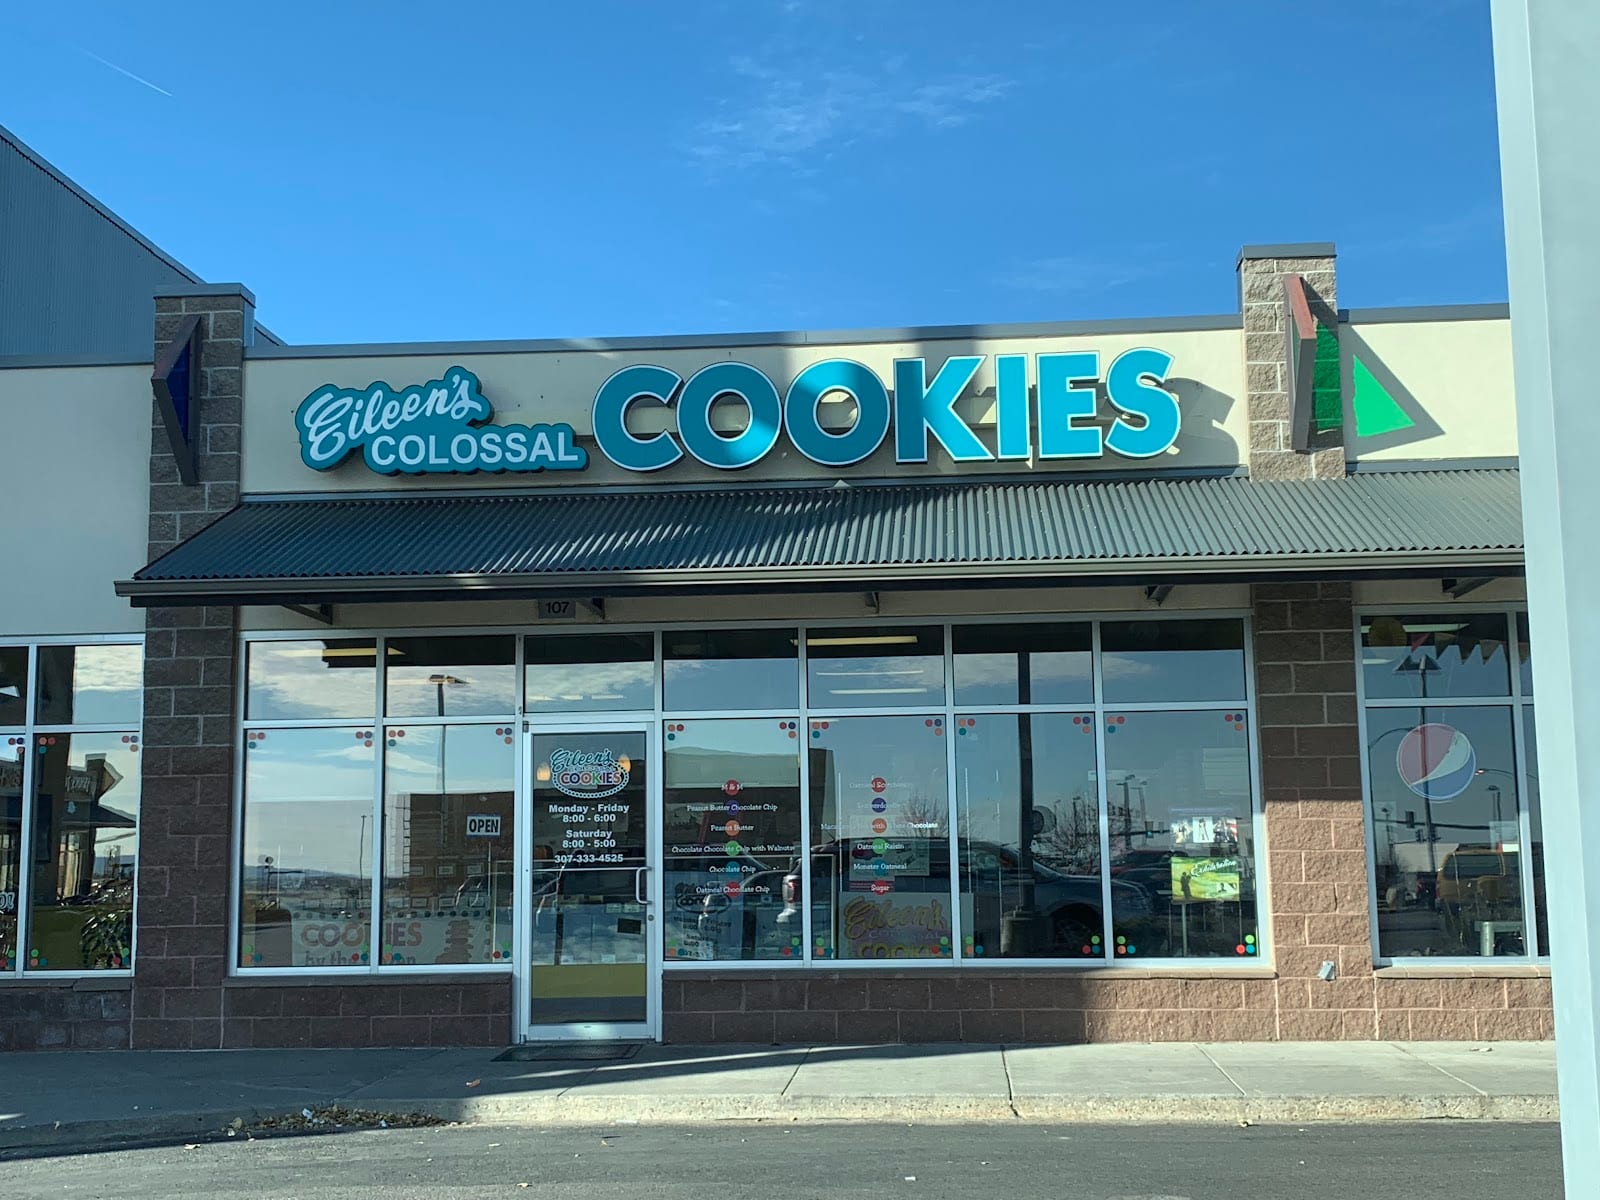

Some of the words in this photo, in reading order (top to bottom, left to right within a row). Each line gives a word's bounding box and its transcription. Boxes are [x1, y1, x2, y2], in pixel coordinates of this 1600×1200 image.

[592, 346, 1182, 472] COOKIES
[303, 373, 483, 461] Eileen's
[371, 430, 579, 466] COLOSSAL
[545, 600, 570, 614] 107
[551, 749, 614, 773] Eileen's
[560, 772, 622, 785] COOKIES
[549, 804, 588, 814] Monday
[598, 804, 629, 813] Friday
[687, 804, 708, 812] Peanut
[731, 803, 762, 811] Chocolate
[763, 803, 778, 811] Chip
[594, 814, 616, 822] 6:00
[468, 818, 499, 834] OPEN
[710, 824, 732, 832] Peanut
[566, 830, 612, 840] Saturday
[562, 840, 585, 848] 8:00
[594, 840, 616, 848] 5:00
[885, 842, 905, 850] Raisin
[703, 845, 734, 853] Chocolate
[554, 854, 624, 863] 307-333-4525
[741, 865, 756, 873] Chip
[696, 886, 721, 894] Oatmeal
[755, 885, 770, 893] Chip
[871, 884, 890, 892] Sugar
